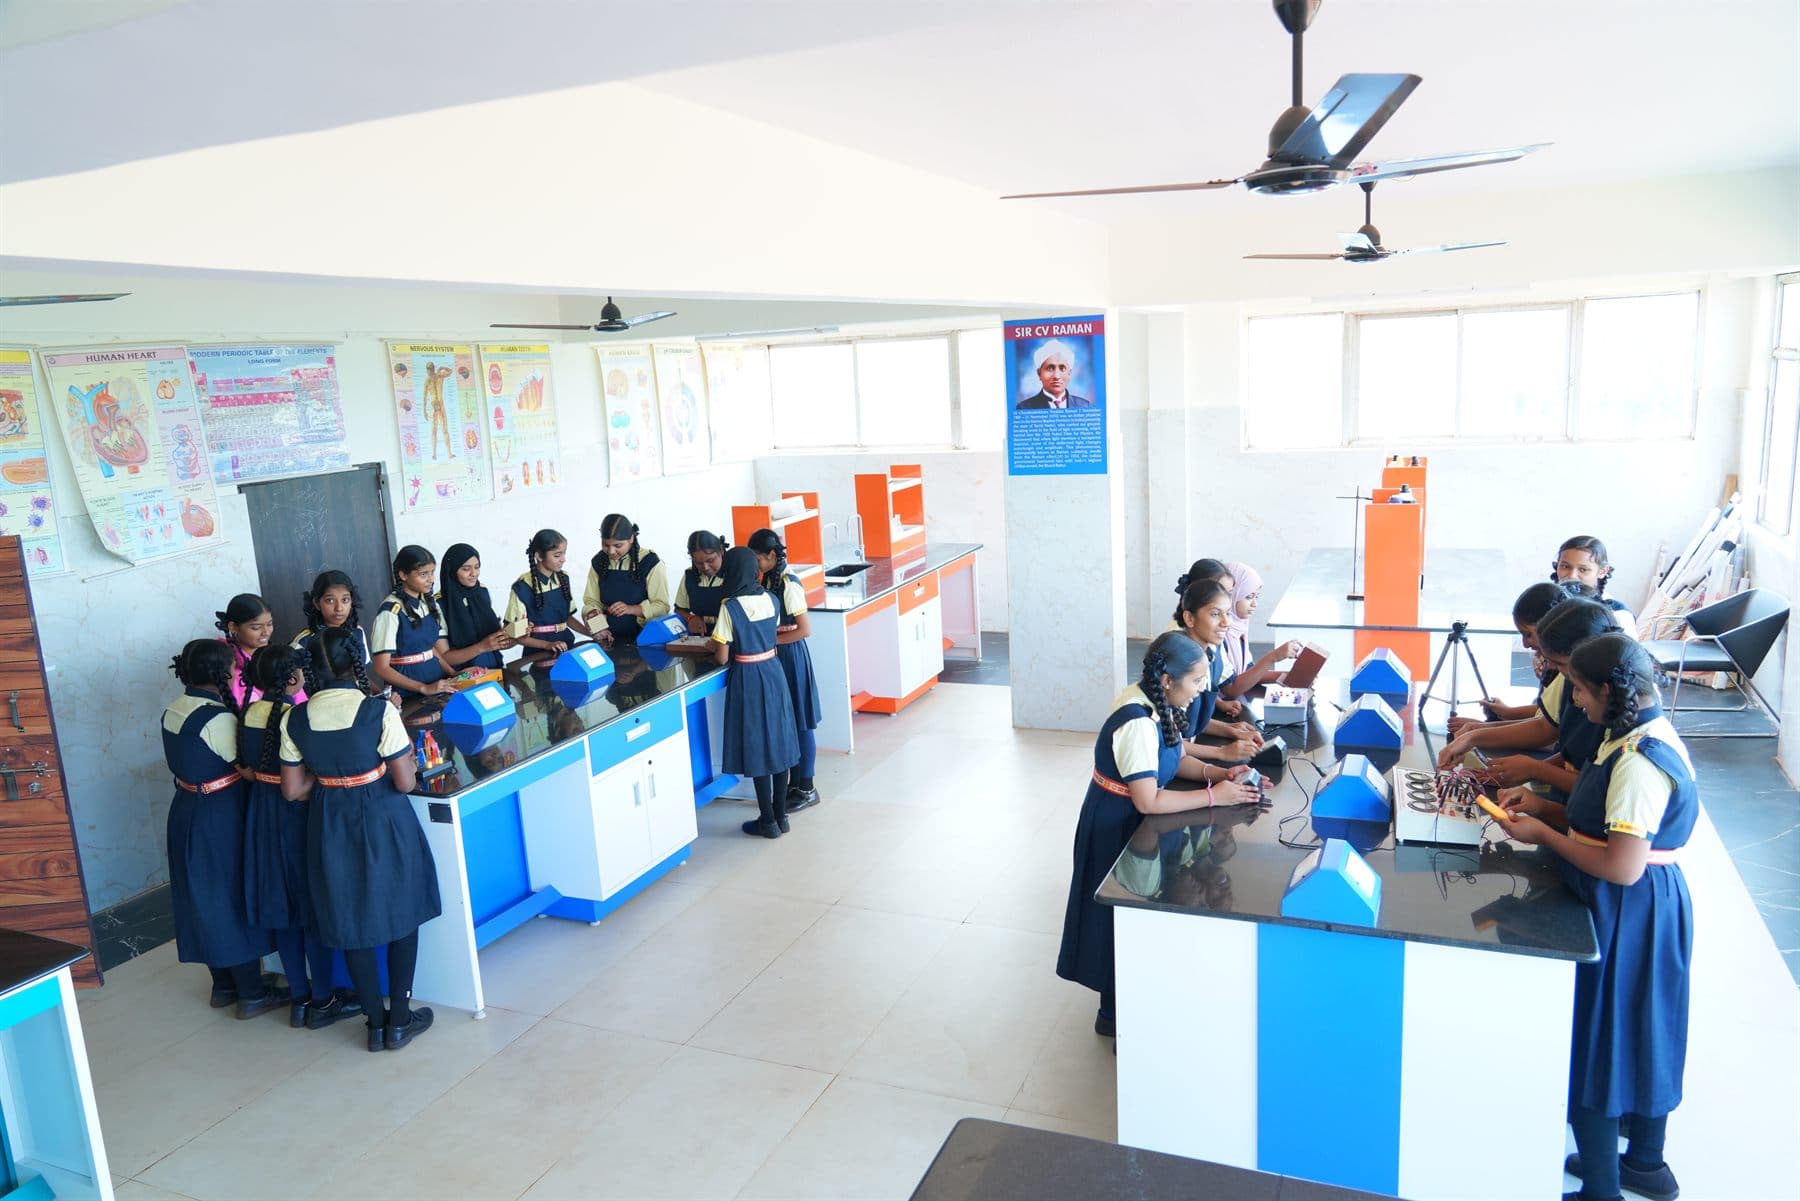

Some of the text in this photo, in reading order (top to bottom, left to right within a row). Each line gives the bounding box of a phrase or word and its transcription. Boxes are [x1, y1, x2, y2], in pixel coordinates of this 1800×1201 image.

[1015, 323, 1093, 338] SIR CV RAMAN
[86, 350, 157, 363] HUMAN HEART
